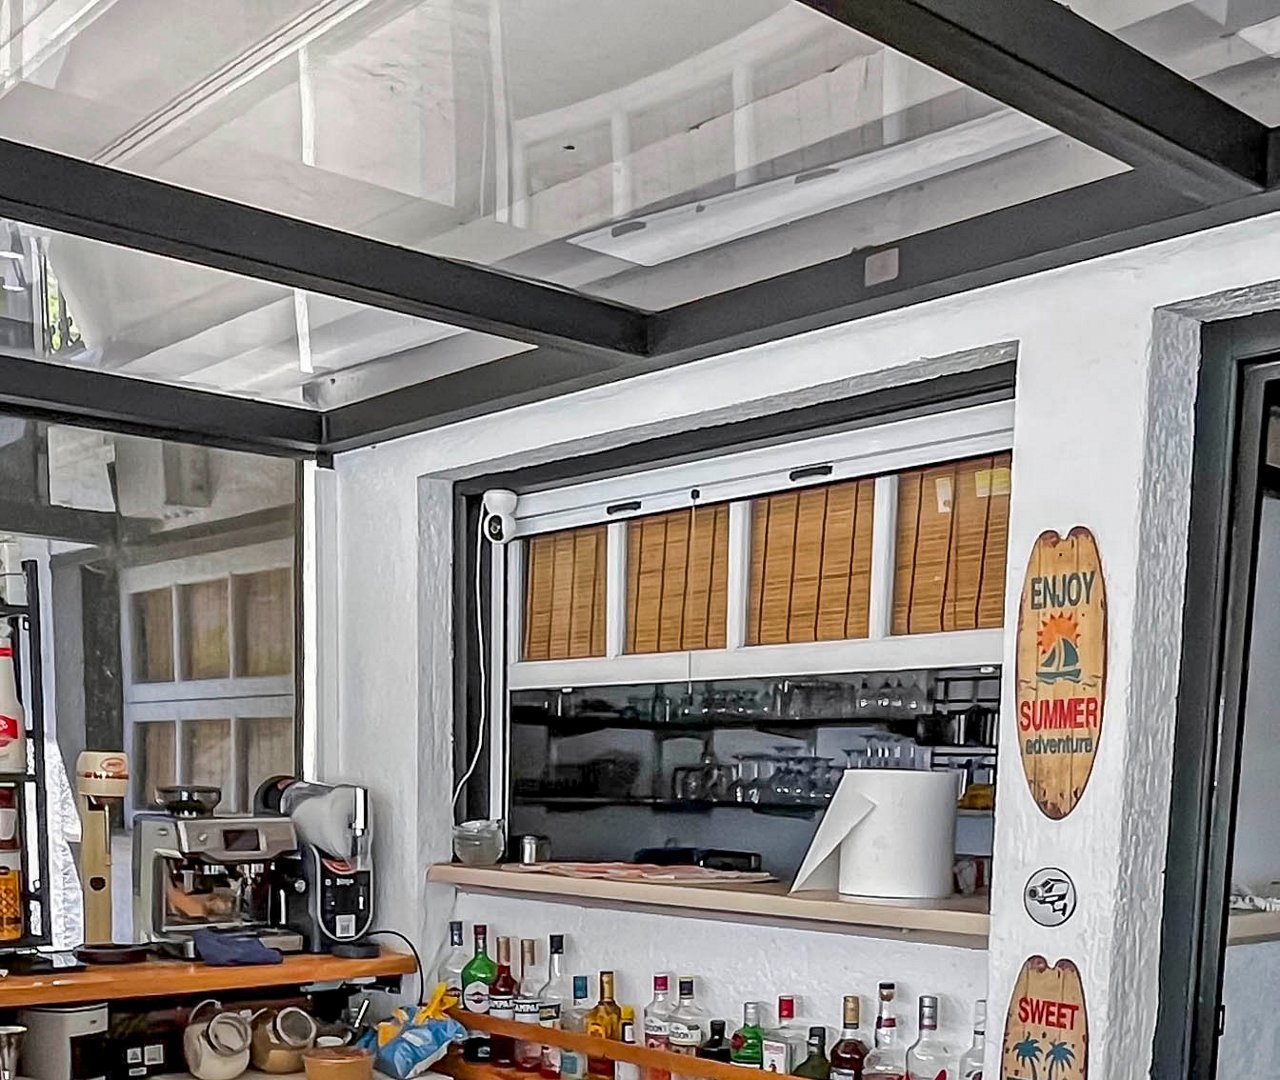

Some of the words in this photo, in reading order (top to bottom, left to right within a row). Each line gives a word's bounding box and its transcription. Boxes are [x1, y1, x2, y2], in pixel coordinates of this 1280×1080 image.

[1030, 571, 1095, 611] ENJOY
[1020, 697, 1097, 732] SUMMER
[1025, 734, 1093, 755] adventure
[1018, 997, 1079, 1031] SWEET
